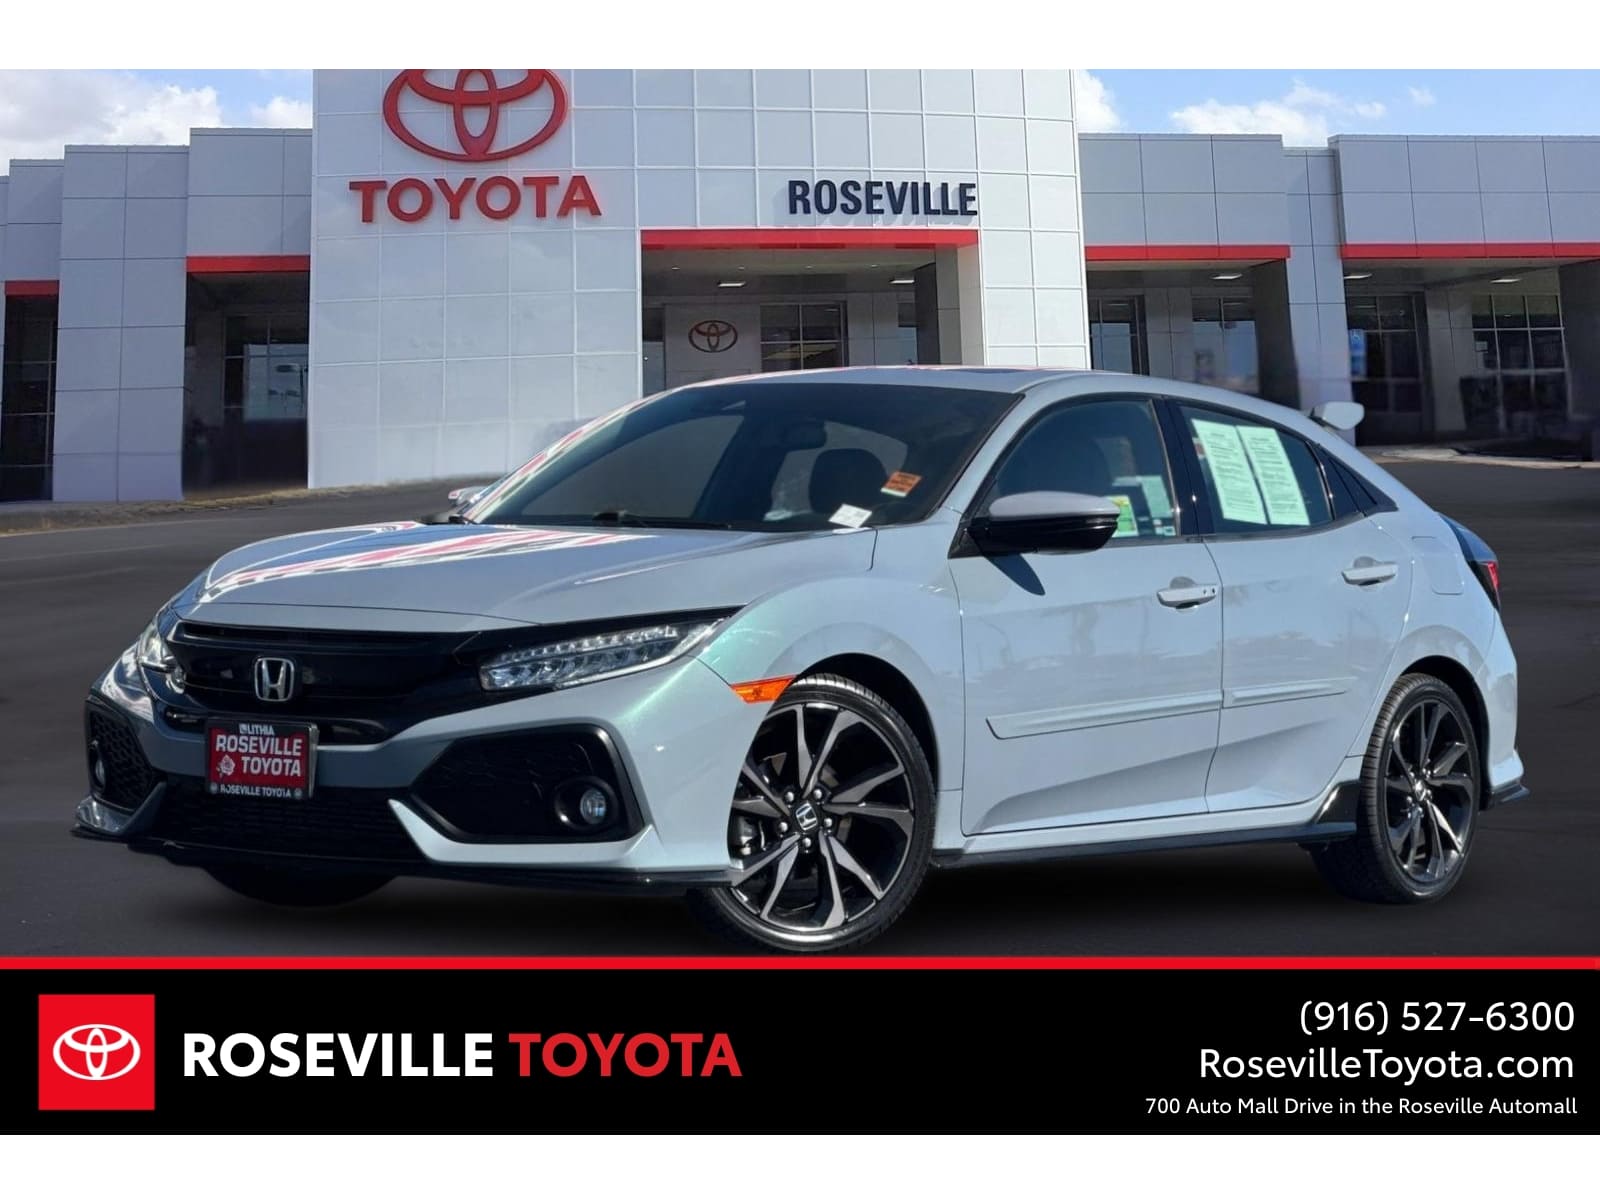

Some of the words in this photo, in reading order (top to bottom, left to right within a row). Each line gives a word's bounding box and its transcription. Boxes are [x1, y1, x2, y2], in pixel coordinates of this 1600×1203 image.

[348, 175, 602, 223] TOYOTA
[788, 179, 978, 216] ROSEVILLE
[215, 734, 302, 756] ROSEVILLE
[241, 756, 301, 777] TOYOTA
